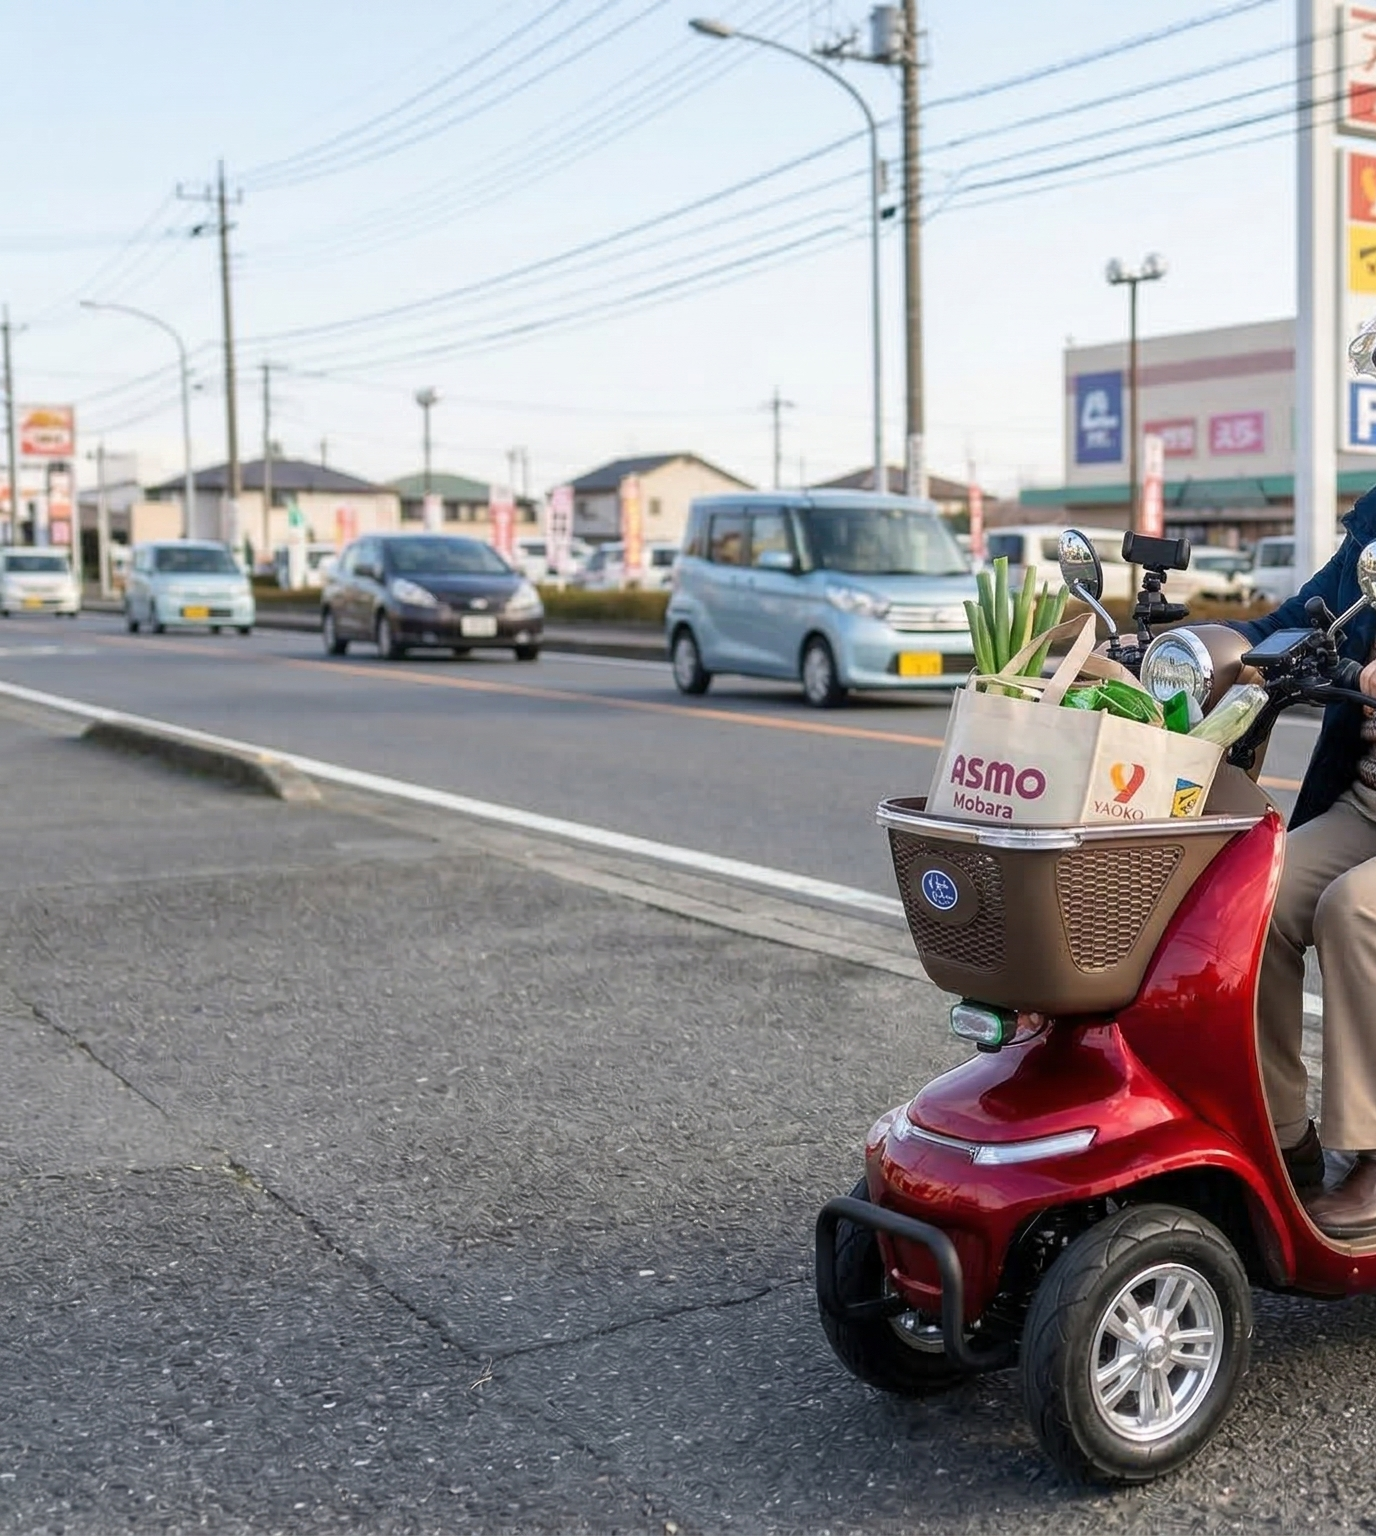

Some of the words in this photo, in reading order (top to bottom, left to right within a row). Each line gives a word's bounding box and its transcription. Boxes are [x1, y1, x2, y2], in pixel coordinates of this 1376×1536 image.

[950, 754, 1046, 800] ASMO
[953, 791, 1013, 820] Mobara
[1094, 801, 1144, 821] YAOKO
